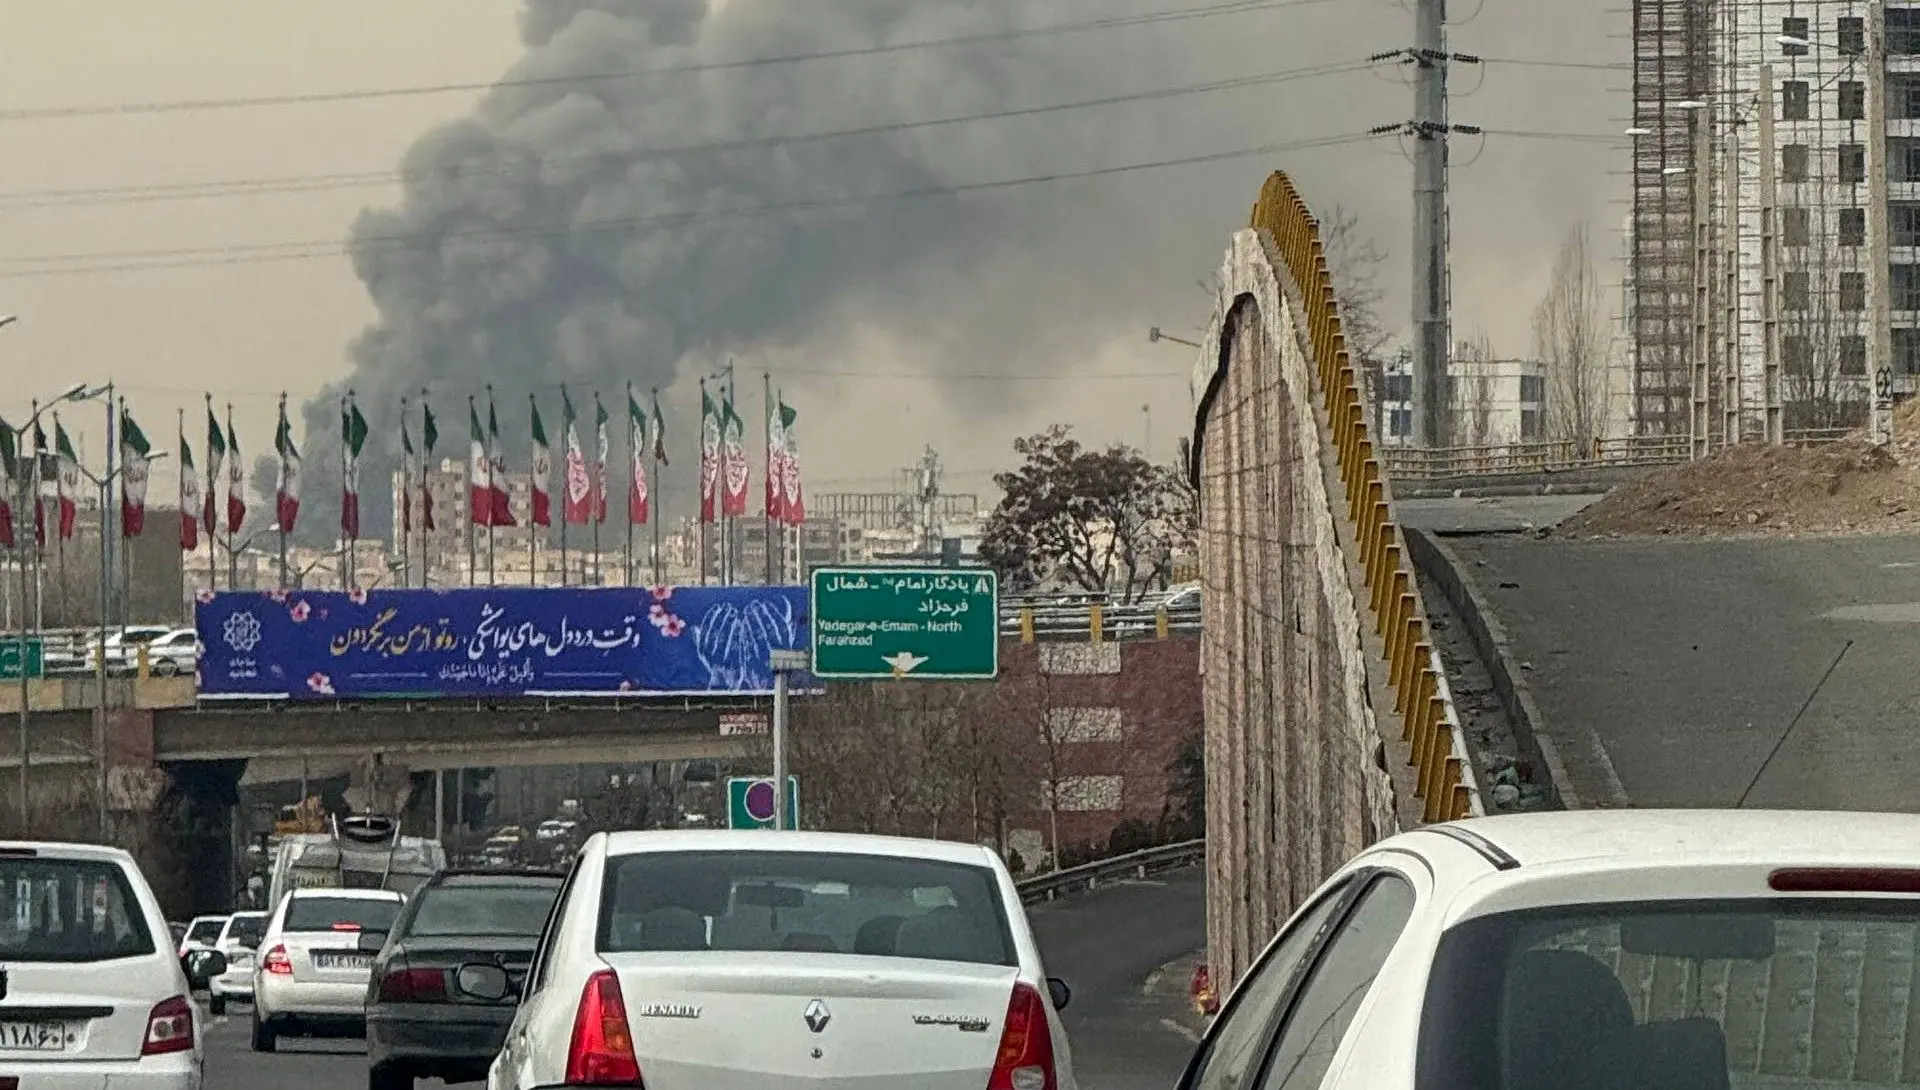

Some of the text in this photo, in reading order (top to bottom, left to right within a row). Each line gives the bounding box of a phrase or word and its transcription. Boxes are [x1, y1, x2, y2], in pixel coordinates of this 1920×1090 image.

[826, 576, 869, 592] شمال
[894, 576, 926, 595] امام
[926, 576, 970, 594] یادگار
[917, 598, 969, 617] فرحزاد
[818, 619, 919, 634] Yadegar-e-Emam
[927, 619, 963, 632] North
[509, 622, 546, 651] های
[818, 634, 873, 647] Farahzad
